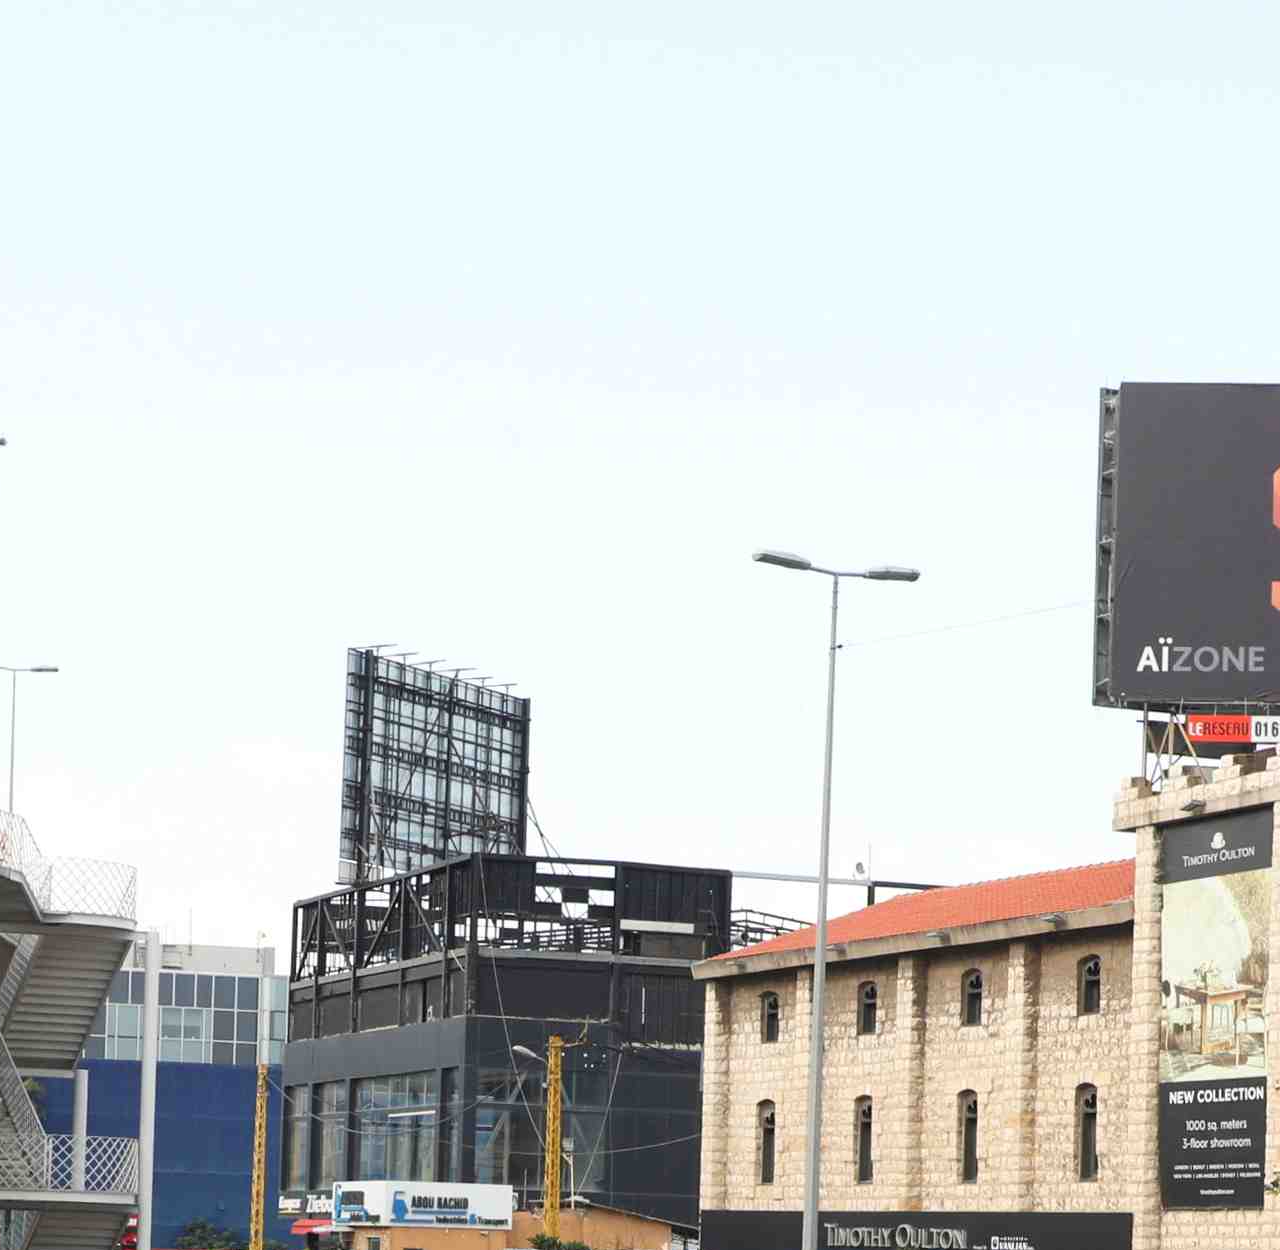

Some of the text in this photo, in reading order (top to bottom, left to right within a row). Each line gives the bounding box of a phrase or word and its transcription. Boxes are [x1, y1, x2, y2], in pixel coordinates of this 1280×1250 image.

[1136, 637, 1265, 672] AÏZONE
[1254, 721, 1269, 737] 01
[1220, 846, 1255, 861] OULTON
[1169, 1086, 1264, 1104] NEW COLLECTION
[1186, 1120, 1206, 1131] 1000
[1220, 1119, 1247, 1130] meters
[1210, 1137, 1251, 1149] showroom
[824, 1222, 968, 1250] TIMOTHY OULTON
